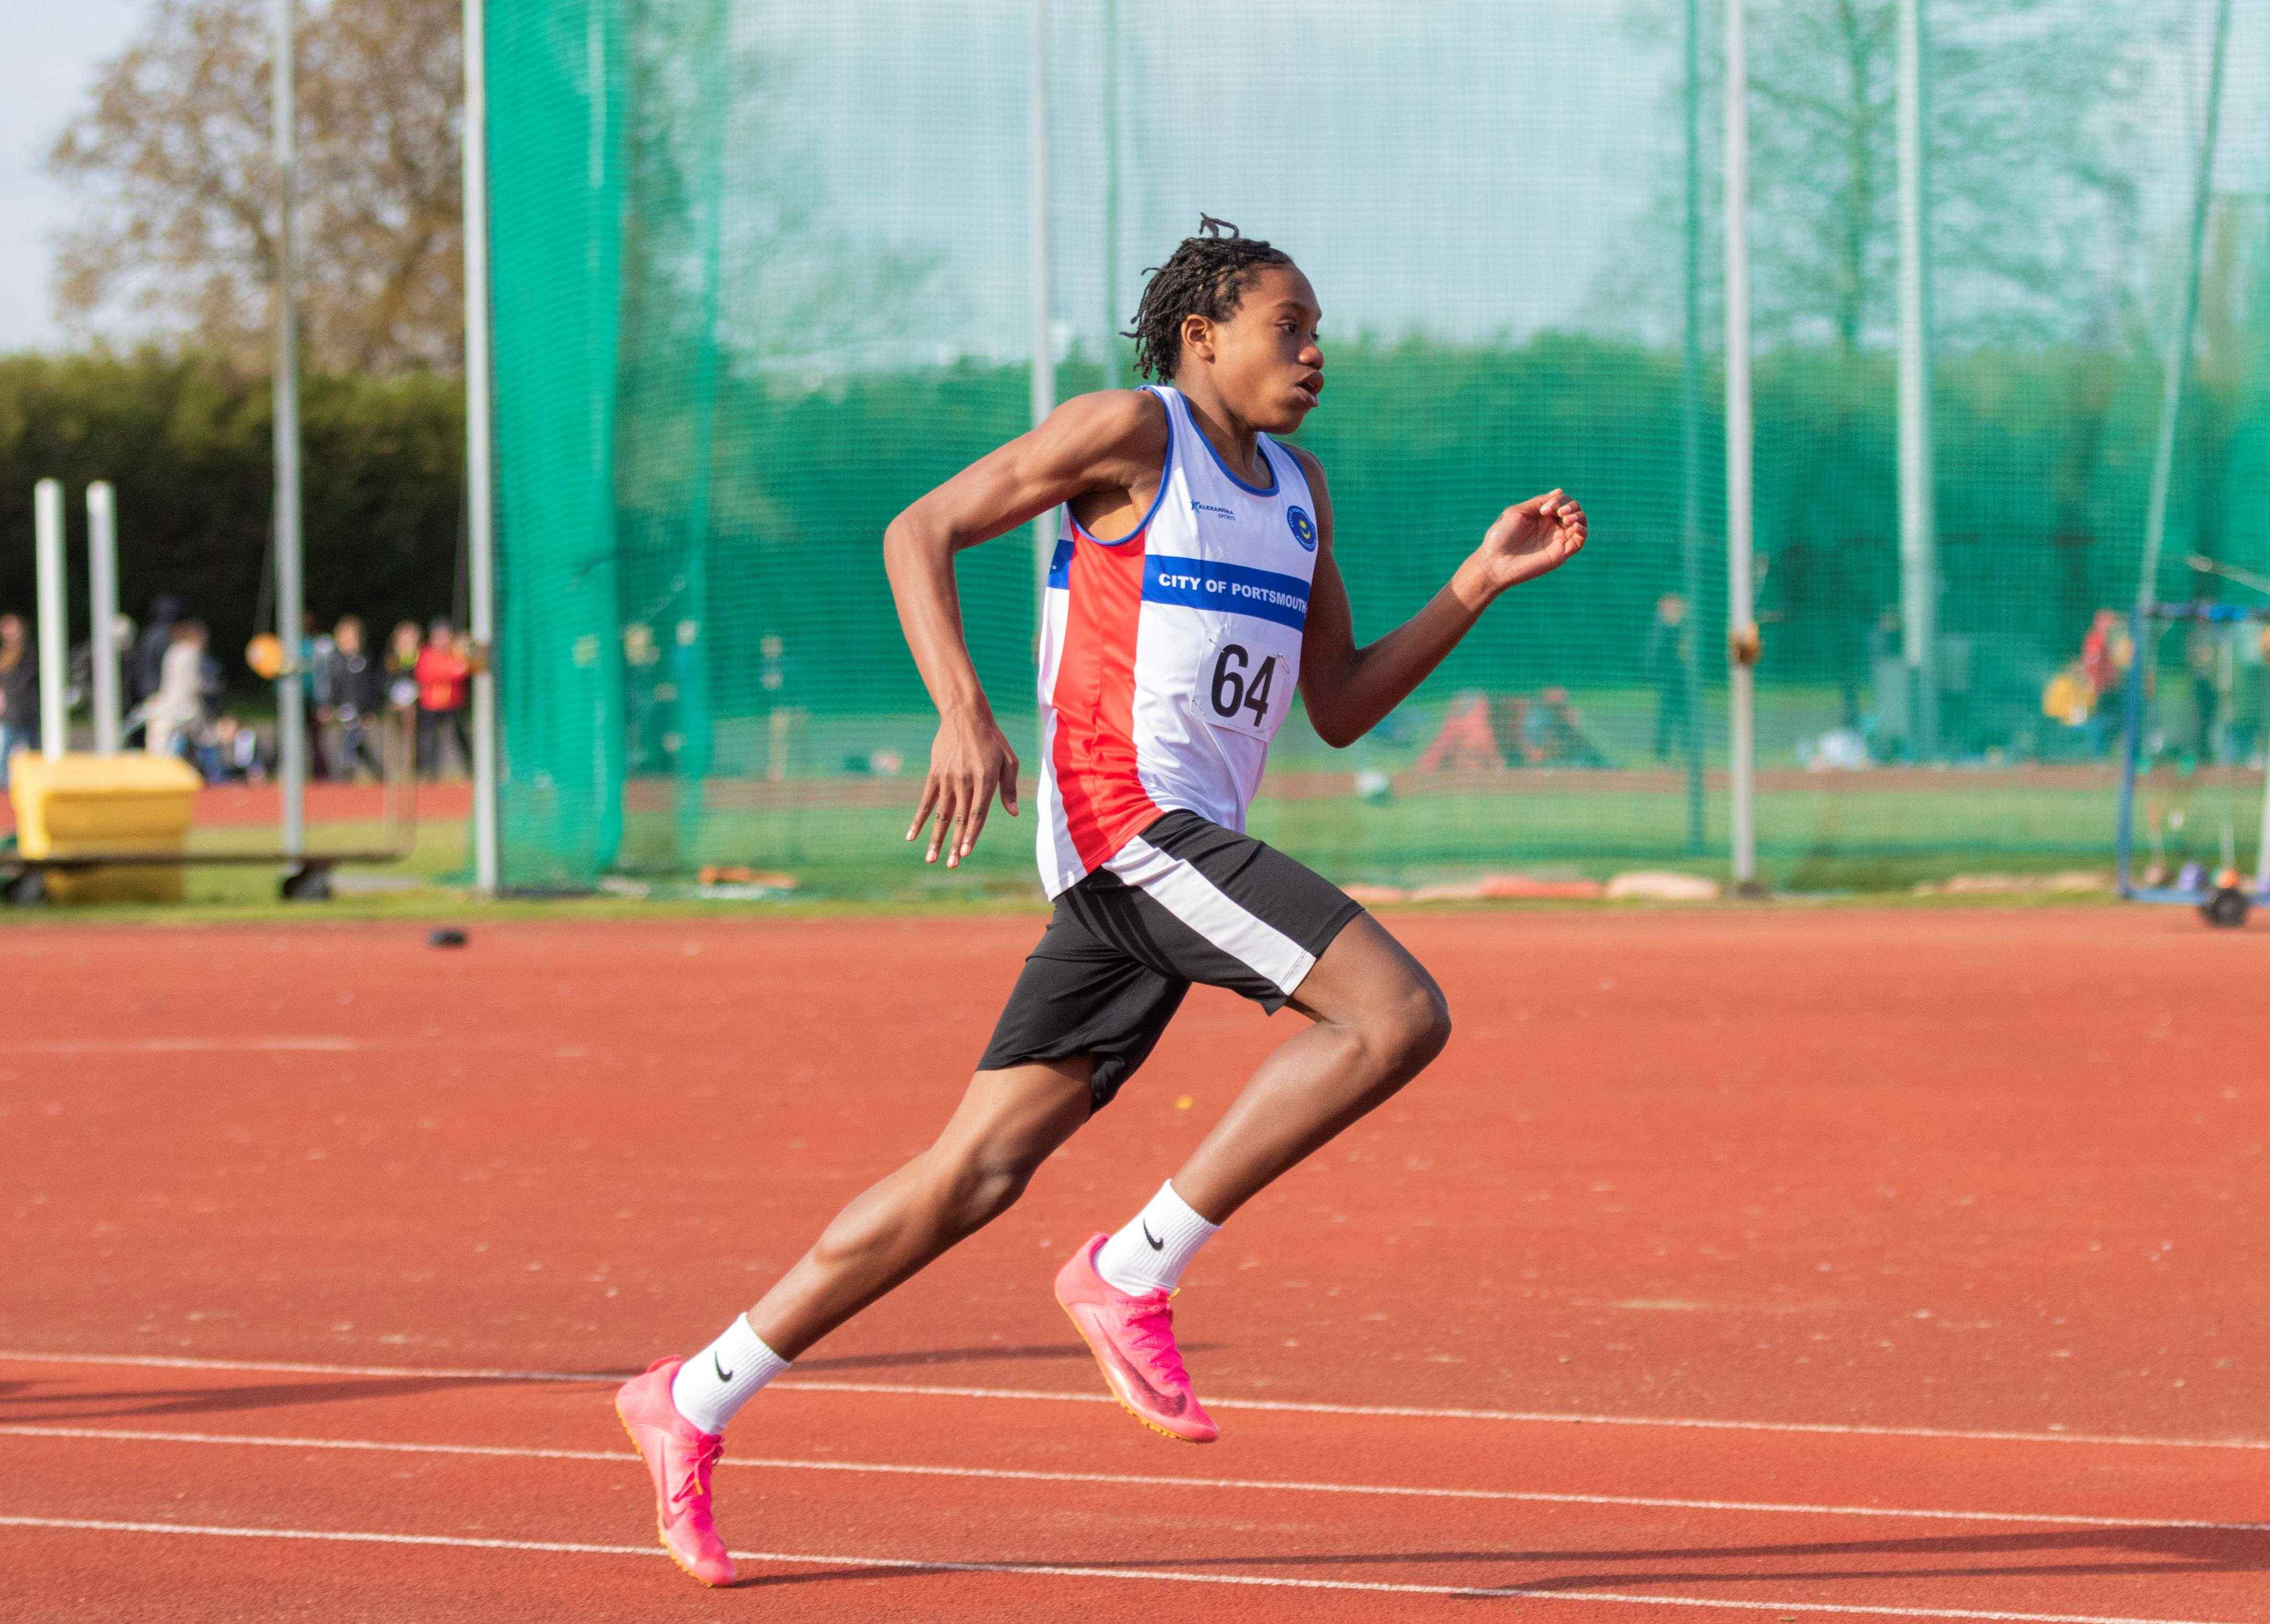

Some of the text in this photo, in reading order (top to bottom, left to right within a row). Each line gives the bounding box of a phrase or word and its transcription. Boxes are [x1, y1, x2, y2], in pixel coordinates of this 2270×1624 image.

[1199, 505, 1234, 514] ALEXANDRA
[1159, 573, 1308, 614] CITY OF PORTSMOUTH
[1211, 644, 1277, 727] 64
